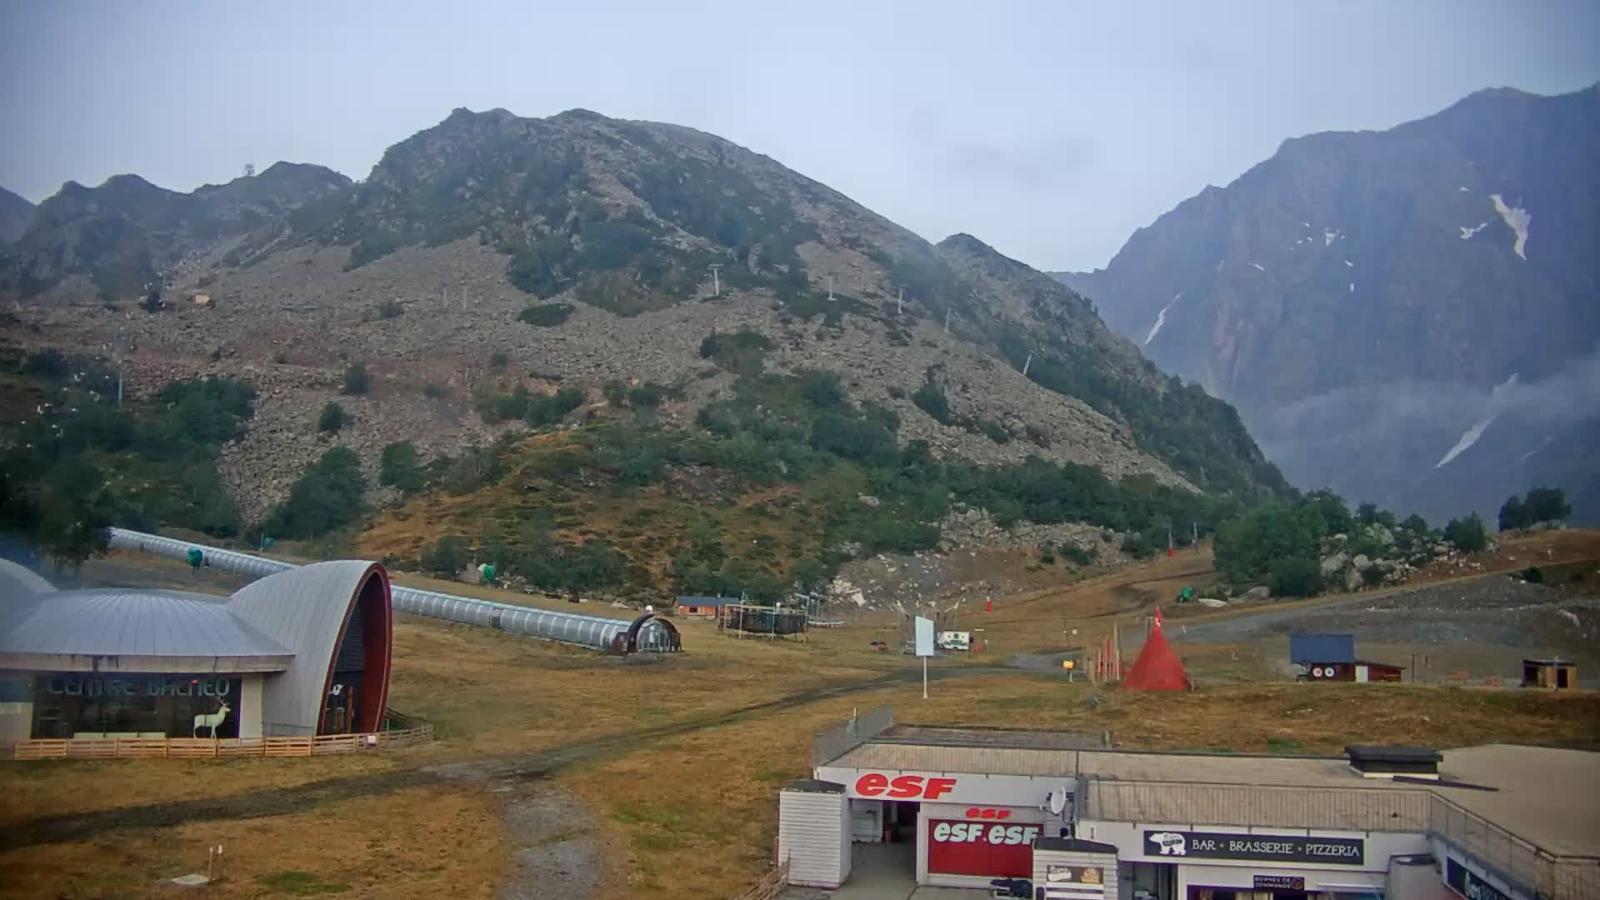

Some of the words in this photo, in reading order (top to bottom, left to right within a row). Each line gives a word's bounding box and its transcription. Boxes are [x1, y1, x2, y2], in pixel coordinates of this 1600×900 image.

[1192, 839, 1216, 851] BAR
[1229, 840, 1294, 854] BRASSERIE
[1305, 844, 1360, 857] PIZZERIA
